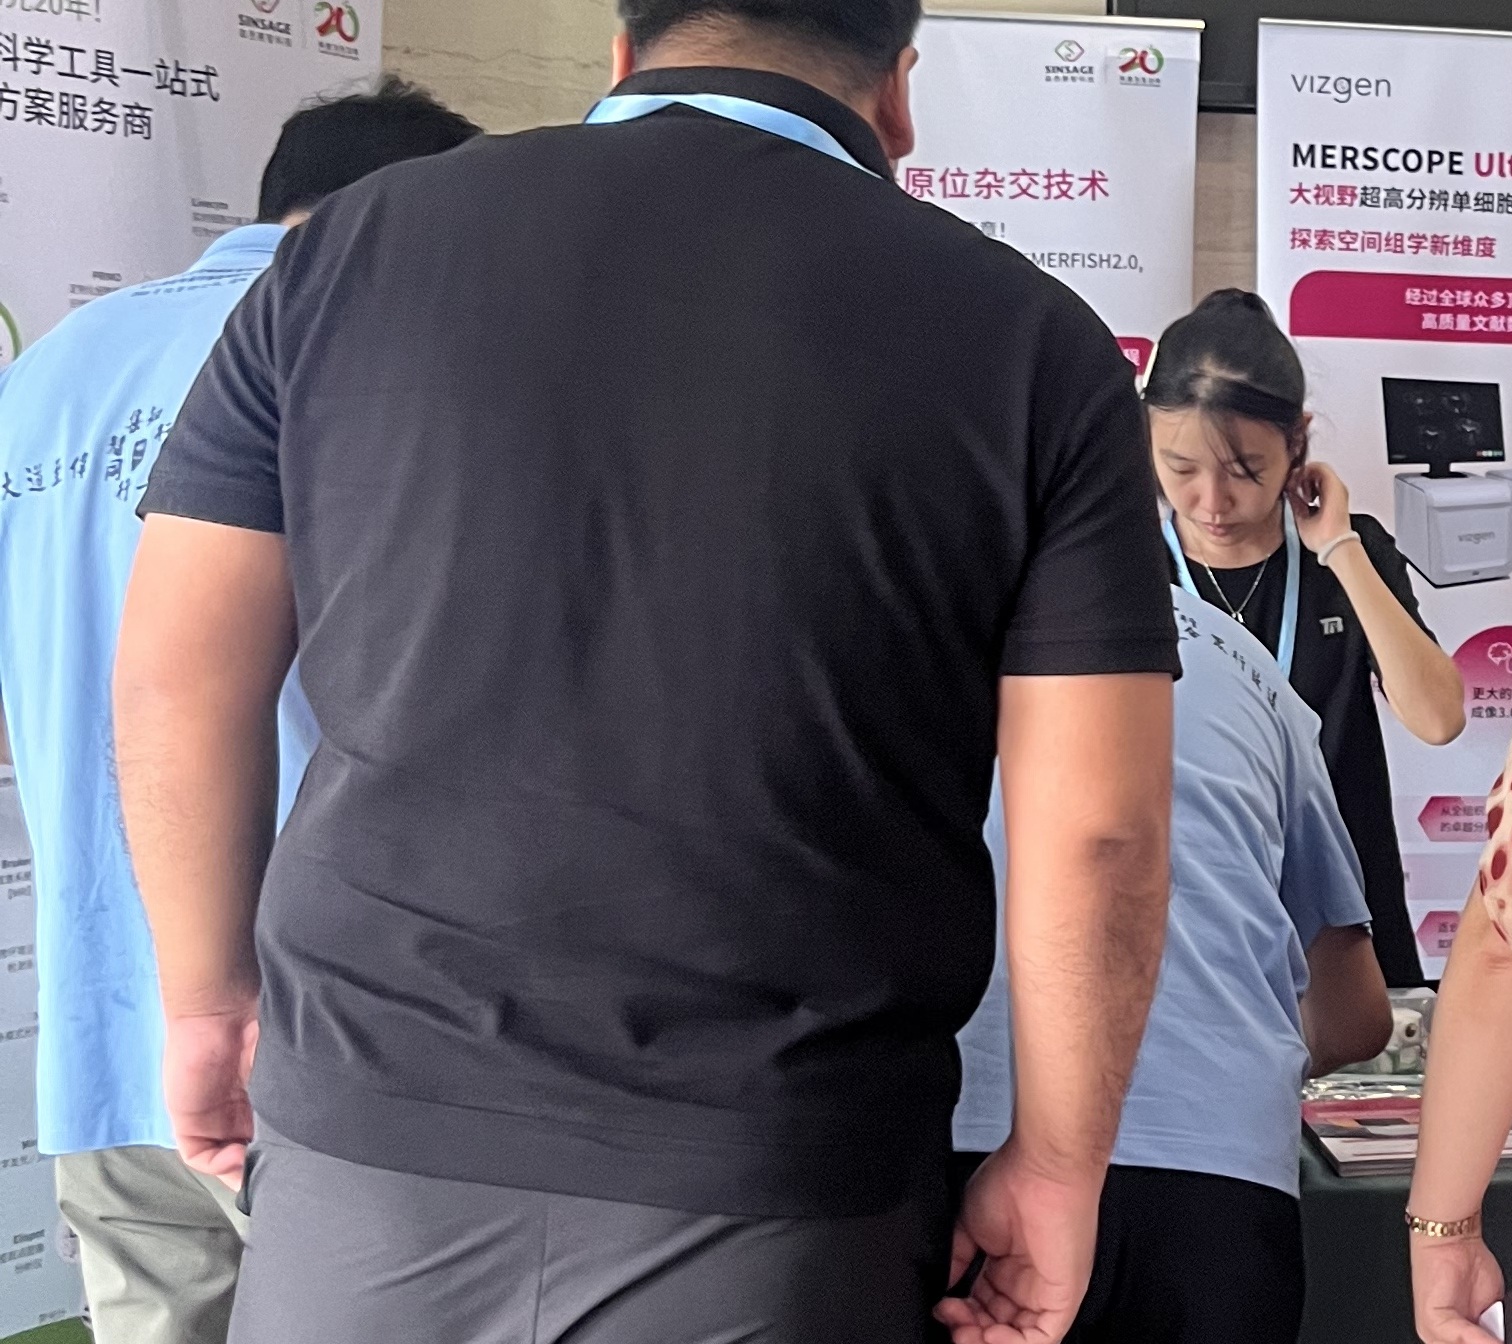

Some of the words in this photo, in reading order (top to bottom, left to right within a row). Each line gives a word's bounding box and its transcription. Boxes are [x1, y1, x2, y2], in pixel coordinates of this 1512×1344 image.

[1045, 65, 1094, 74] SINSAGE
[1291, 74, 1391, 103] vizgen
[0, 82, 153, 140] 方案服务商
[1292, 143, 1464, 176] MERSCOPE
[904, 167, 1110, 201] 原位杂交技术
[1290, 227, 1497, 259] 探索空间组学新维度
[1024, 251, 1144, 274] MERFISH2.0,
